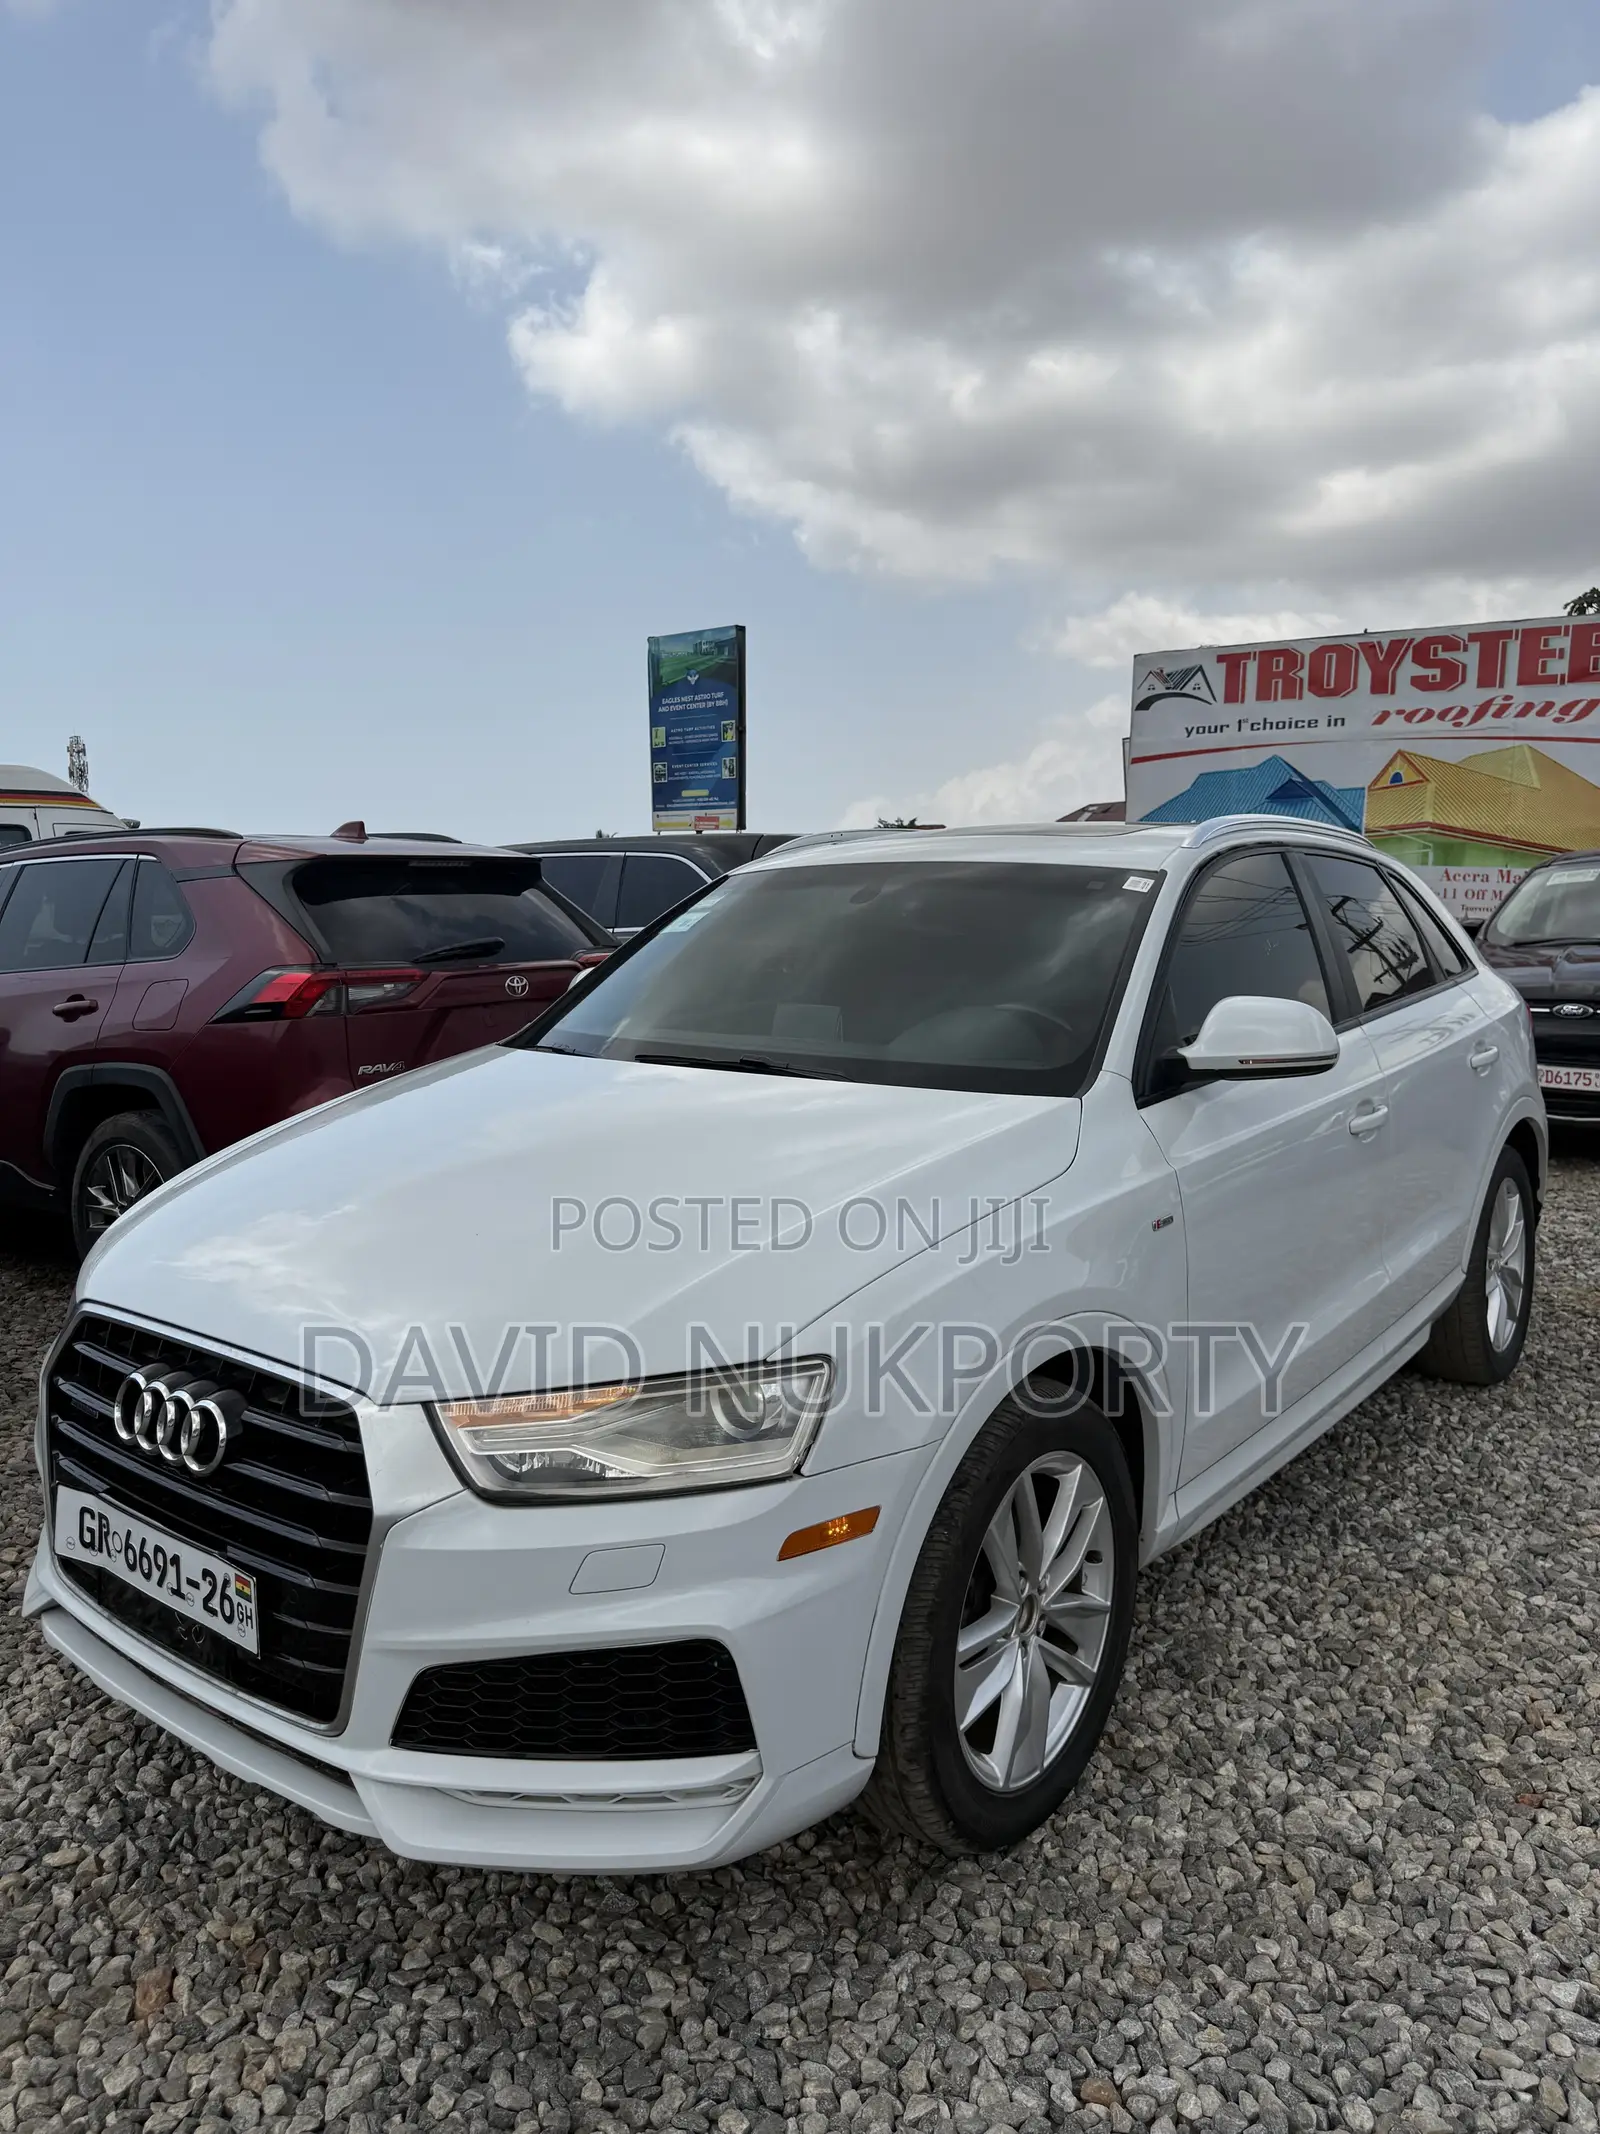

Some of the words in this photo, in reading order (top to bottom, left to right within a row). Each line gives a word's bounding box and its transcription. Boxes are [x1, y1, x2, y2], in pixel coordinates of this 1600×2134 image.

[1217, 622, 1600, 704] TROYSTEE
[662, 696, 680, 704] EAGLES
[694, 692, 711, 701] ASTRO
[711, 691, 724, 699] TURF
[686, 702, 706, 710] CENTER
[1184, 722, 1230, 738] your
[1250, 717, 1319, 732] choice
[1327, 714, 1346, 728] in
[1371, 694, 1600, 728] roofing
[1440, 867, 1490, 883] Accra
[1496, 868, 1529, 885] Ma
[357, 1060, 406, 1076] RAV4
[78, 1505, 112, 1558] GR
[124, 1529, 235, 1624] 6691-26
[236, 1601, 254, 1630] GH
